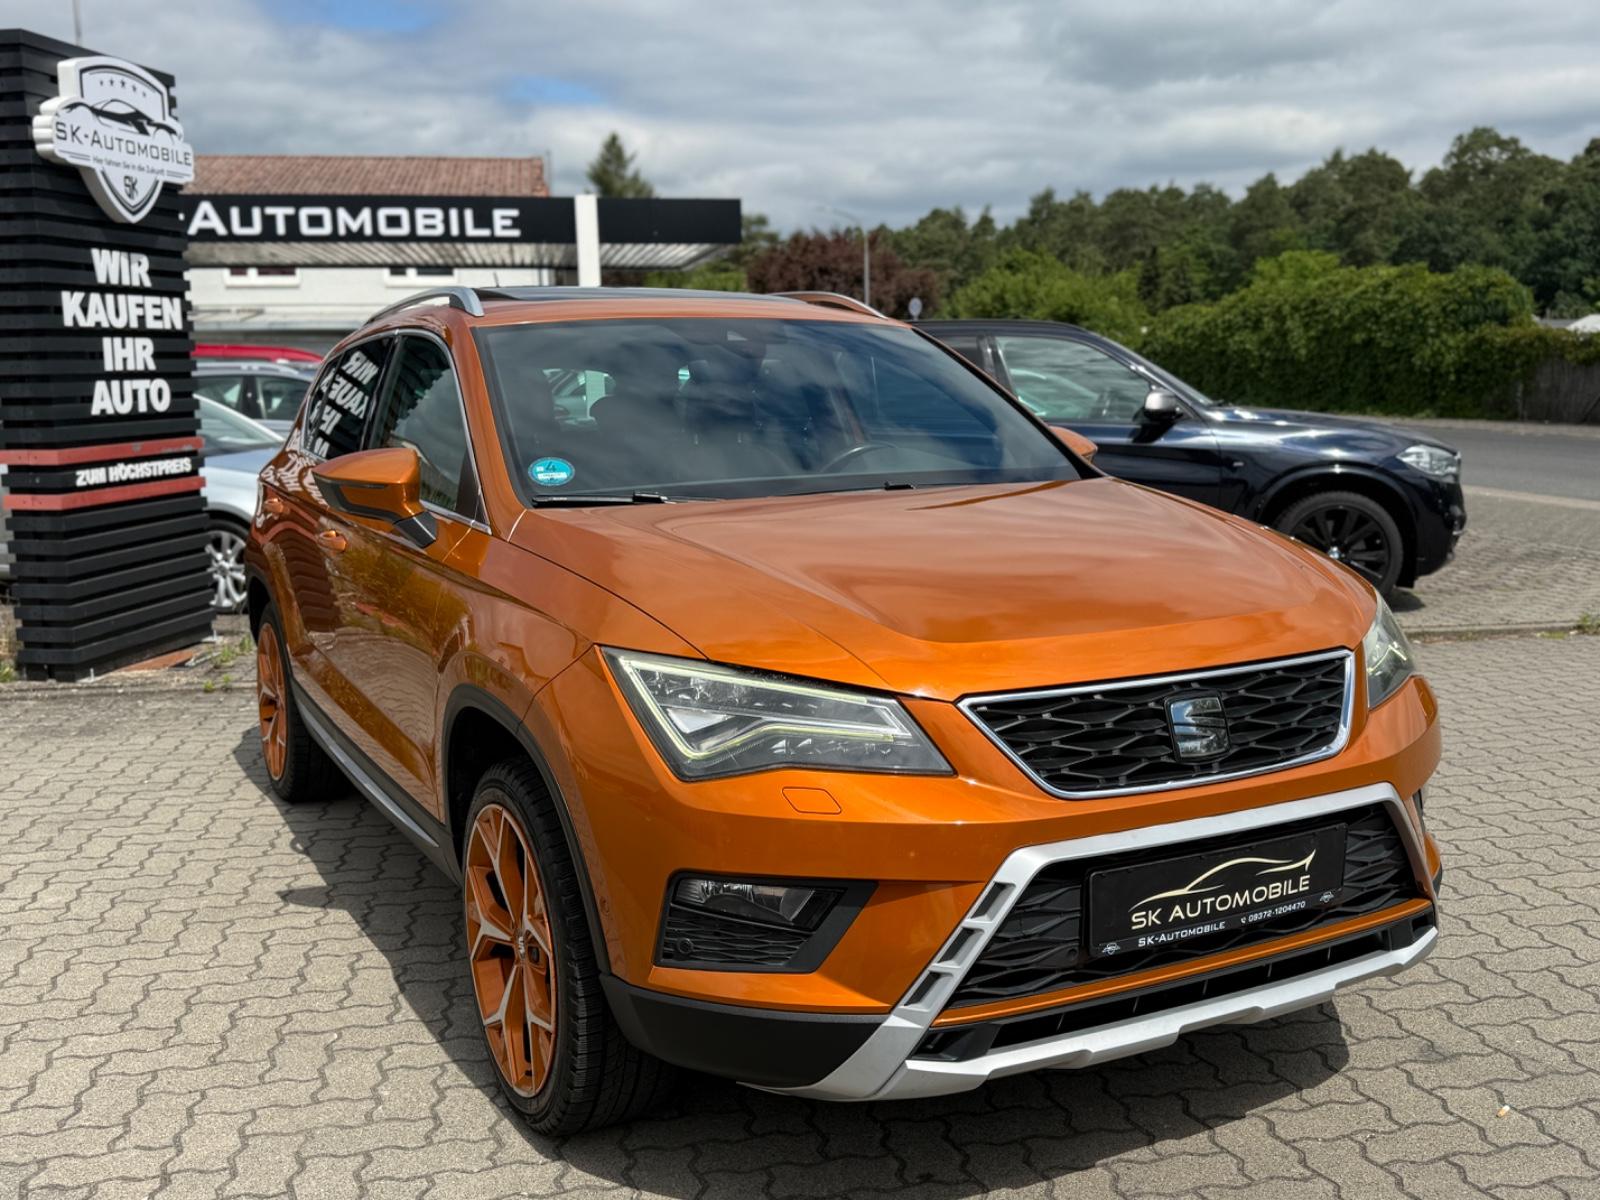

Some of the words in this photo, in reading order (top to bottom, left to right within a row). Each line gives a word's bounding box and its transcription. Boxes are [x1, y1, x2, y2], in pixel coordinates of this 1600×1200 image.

[90, 248, 152, 288] WIR
[61, 290, 183, 330] KAUFEN
[102, 337, 156, 371] IHR
[91, 378, 171, 416] AUTO
[75, 466, 107, 488] ZUM
[108, 457, 192, 482] HÖCHSTPREIS
[1131, 908, 1162, 930] SK
[1168, 874, 1311, 922] AUTOMOBILE
[1137, 921, 1226, 948] SK-AUTOMOBILE
